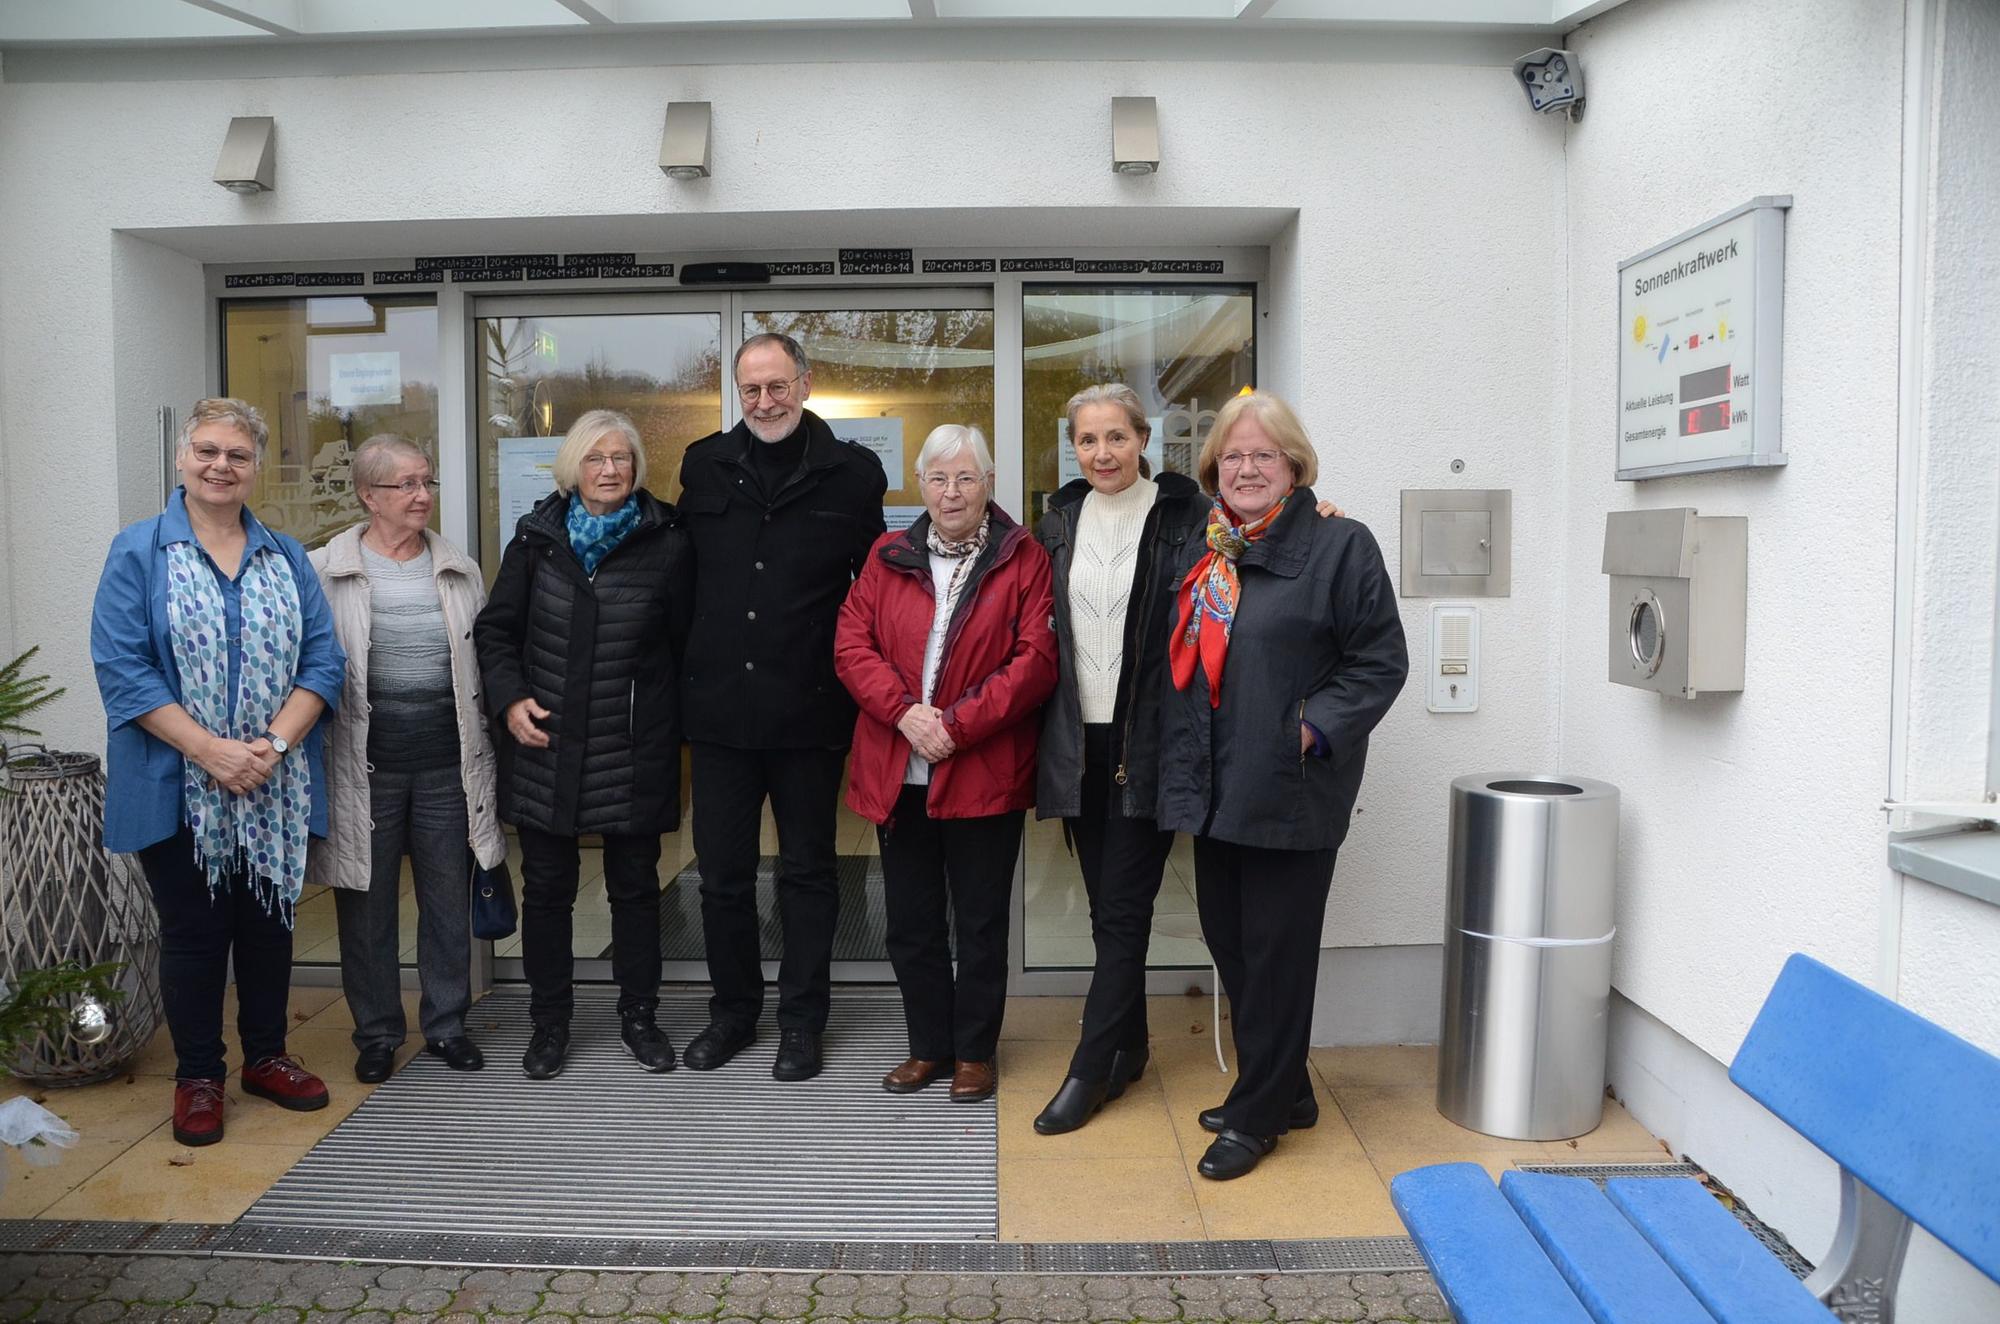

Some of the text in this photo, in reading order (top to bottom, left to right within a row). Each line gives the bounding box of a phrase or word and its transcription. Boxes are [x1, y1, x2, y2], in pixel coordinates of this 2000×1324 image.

[1634, 238, 1739, 298] Sonnenkraftwerk
[1733, 375, 1750, 389] Watt
[1625, 392, 1673, 412] Aktuelle Leistung
[1732, 410, 1748, 424] kWh
[1624, 425, 1667, 442] Gesamtenergie
